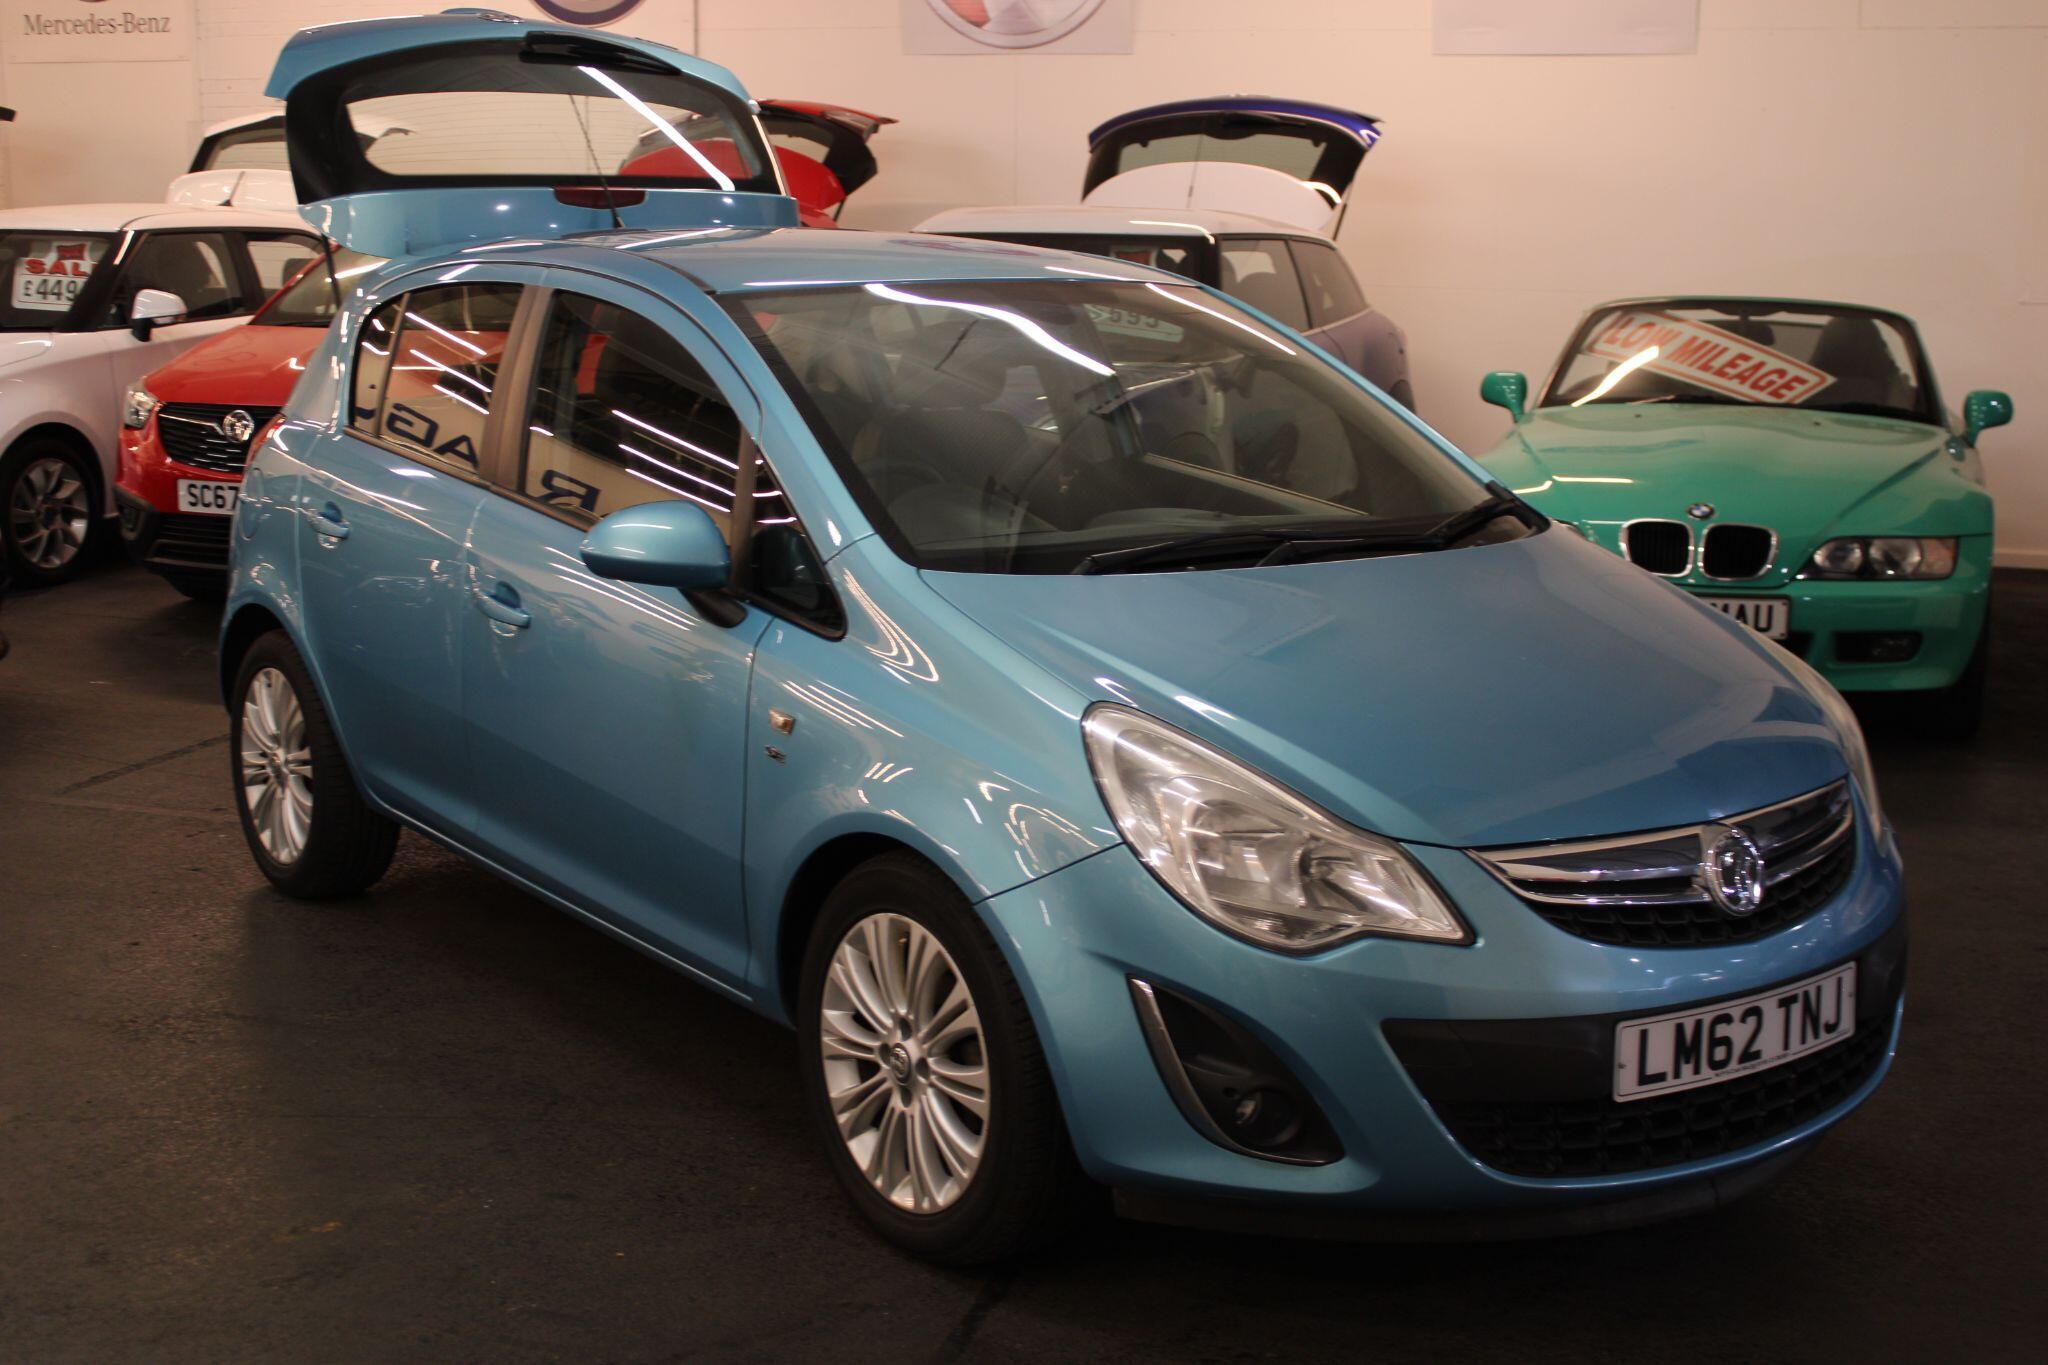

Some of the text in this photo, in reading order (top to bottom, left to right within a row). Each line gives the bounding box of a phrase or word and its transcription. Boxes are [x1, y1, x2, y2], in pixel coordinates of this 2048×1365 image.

[24, 12, 171, 35] Mercedes-Benz
[24, 258, 98, 277] SAL
[1603, 317, 1809, 399] LOW MILEAGE
[187, 483, 239, 511] SC67
[1638, 976, 1843, 1086] LM62 TNJ
